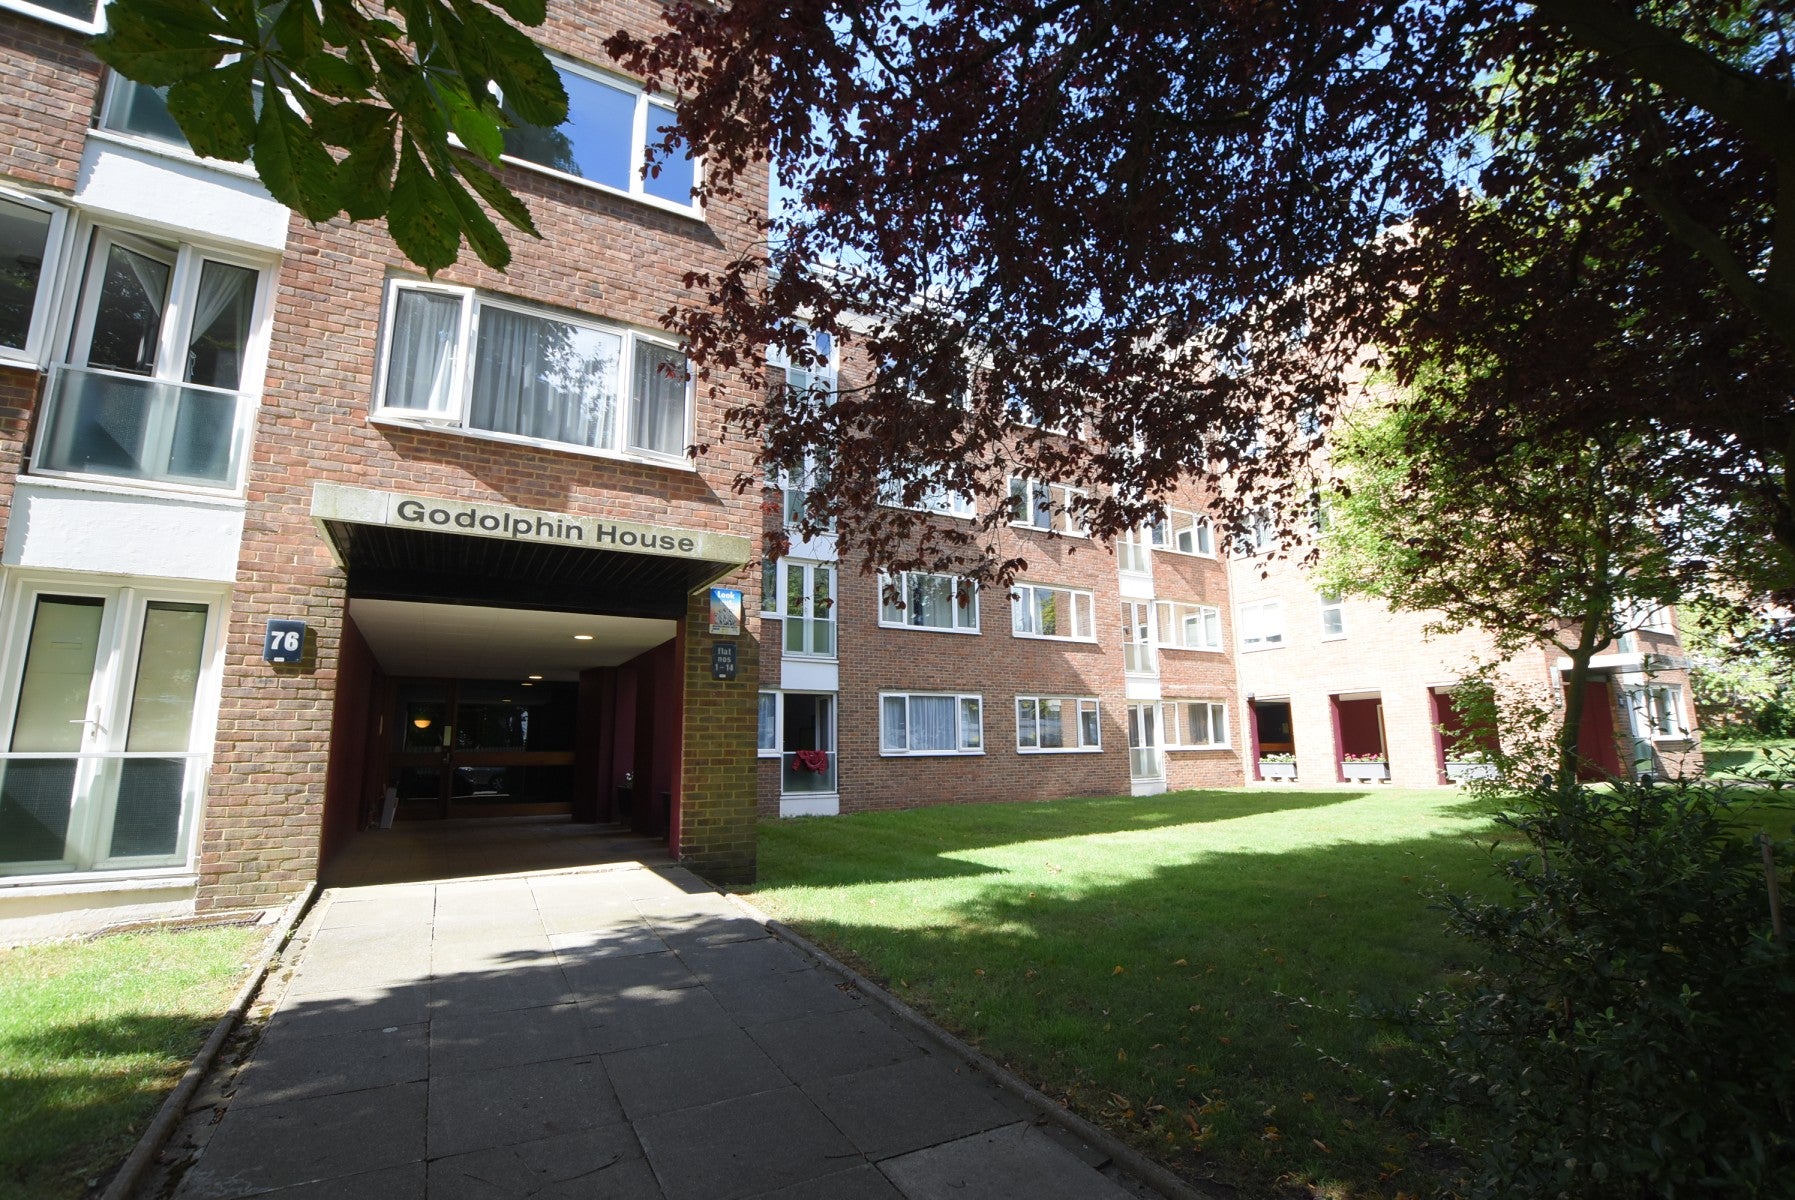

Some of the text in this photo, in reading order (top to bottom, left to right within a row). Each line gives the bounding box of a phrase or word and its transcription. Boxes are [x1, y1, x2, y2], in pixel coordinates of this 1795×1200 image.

[397, 500, 695, 552] Godolphin House
[270, 630, 300, 652] 76
[717, 647, 731, 656] flat
